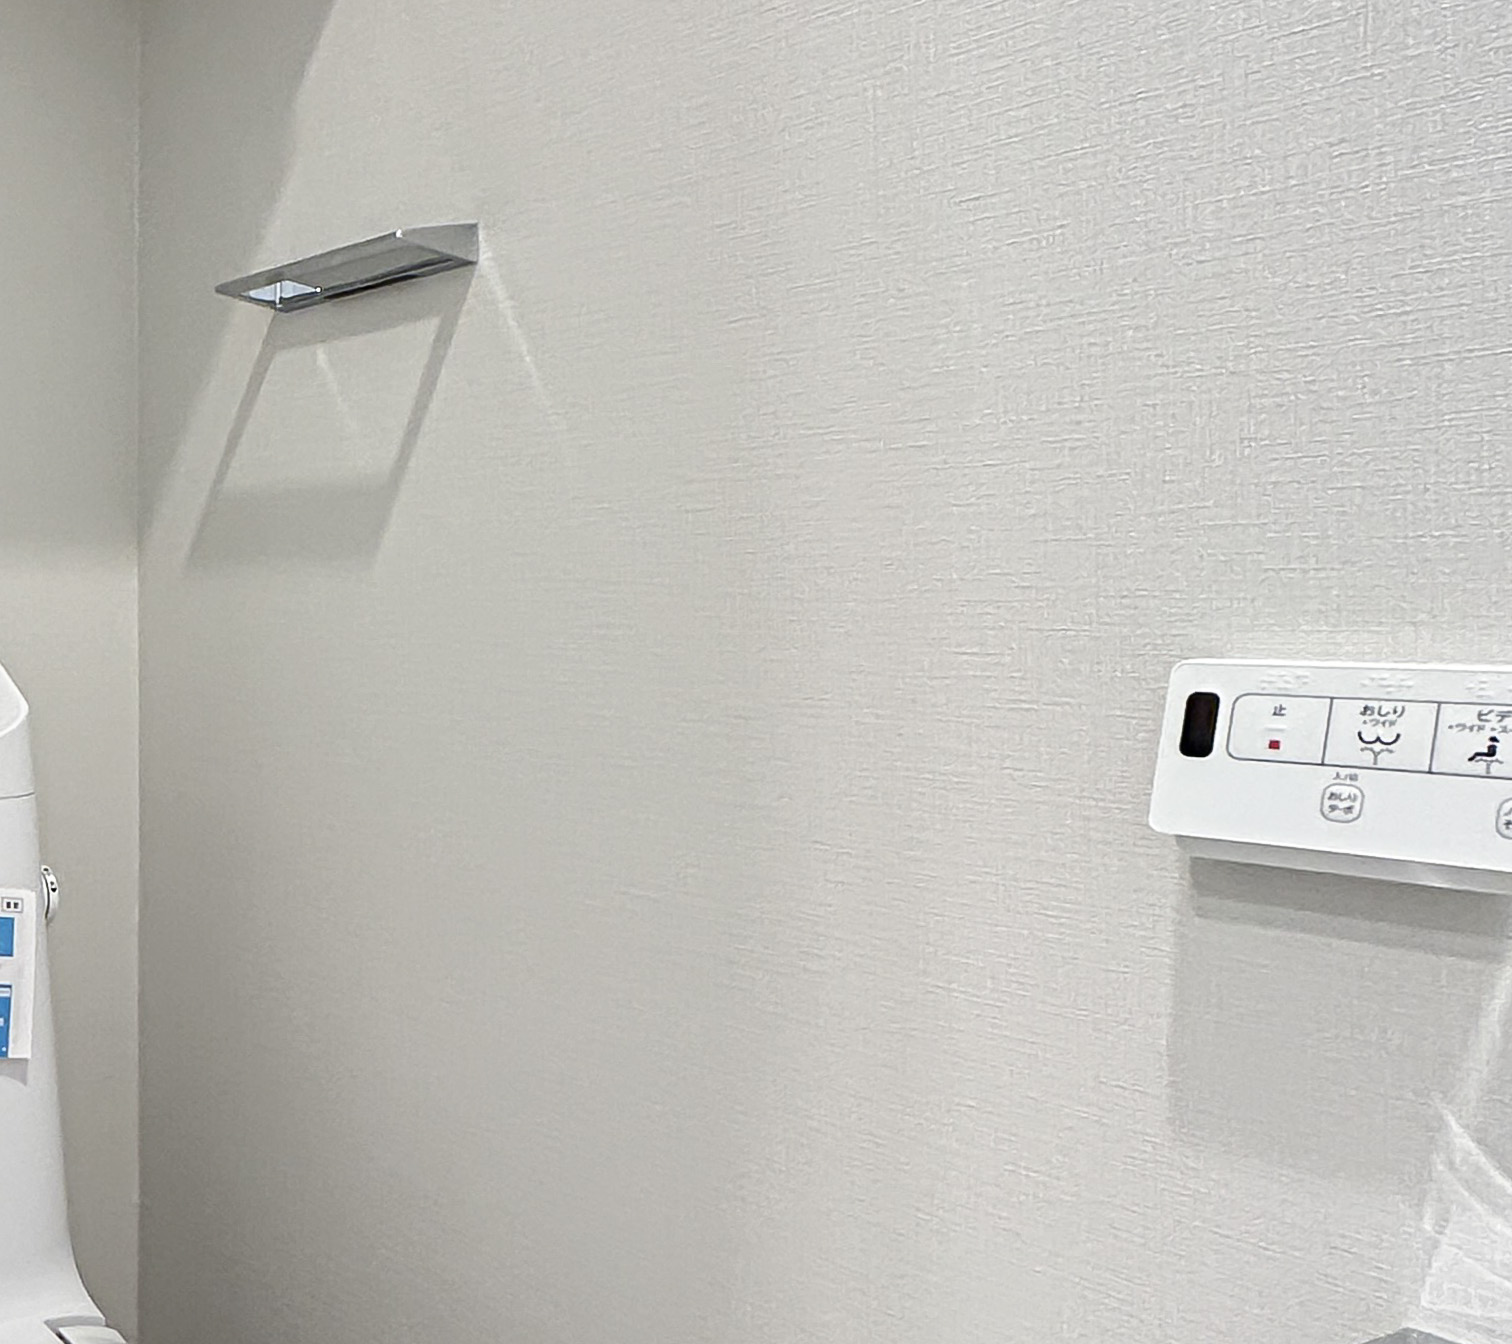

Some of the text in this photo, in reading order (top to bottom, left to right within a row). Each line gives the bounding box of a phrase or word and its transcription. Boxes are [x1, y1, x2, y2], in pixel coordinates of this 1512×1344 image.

[1271, 703, 1287, 717] 止
[1359, 704, 1406, 718] おしり
